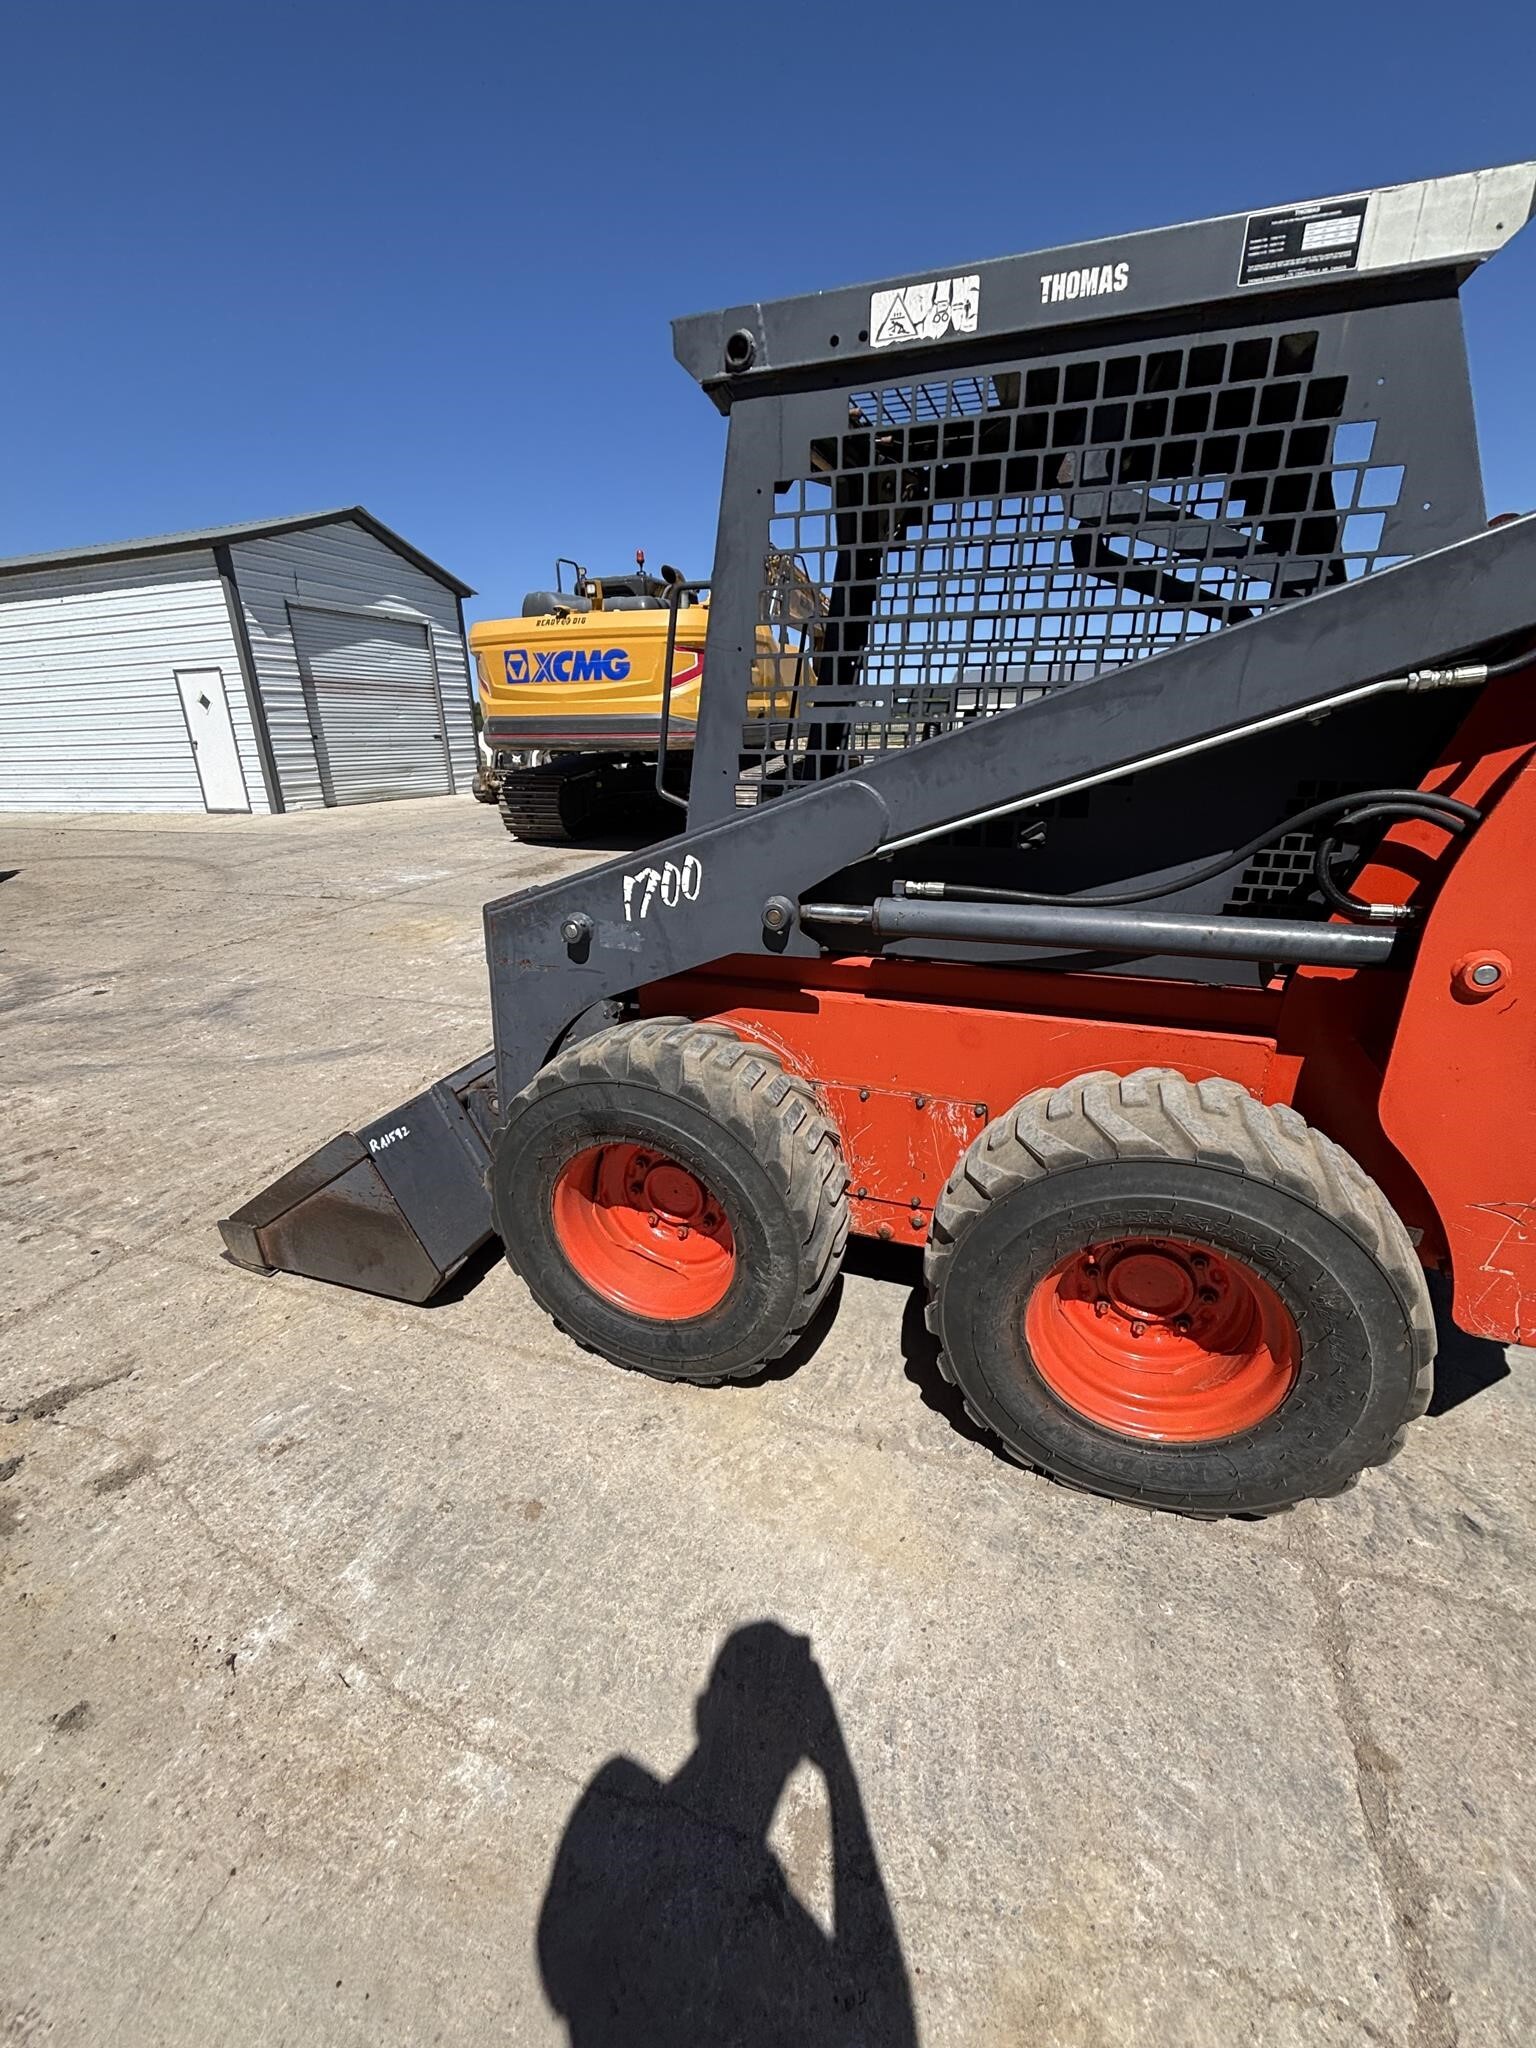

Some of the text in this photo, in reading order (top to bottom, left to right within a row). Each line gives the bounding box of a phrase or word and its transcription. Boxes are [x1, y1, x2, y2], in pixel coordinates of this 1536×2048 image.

[1040, 262, 1129, 304] THOMAS
[531, 648, 631, 683] XCMG
[624, 854, 702, 921] 1700
